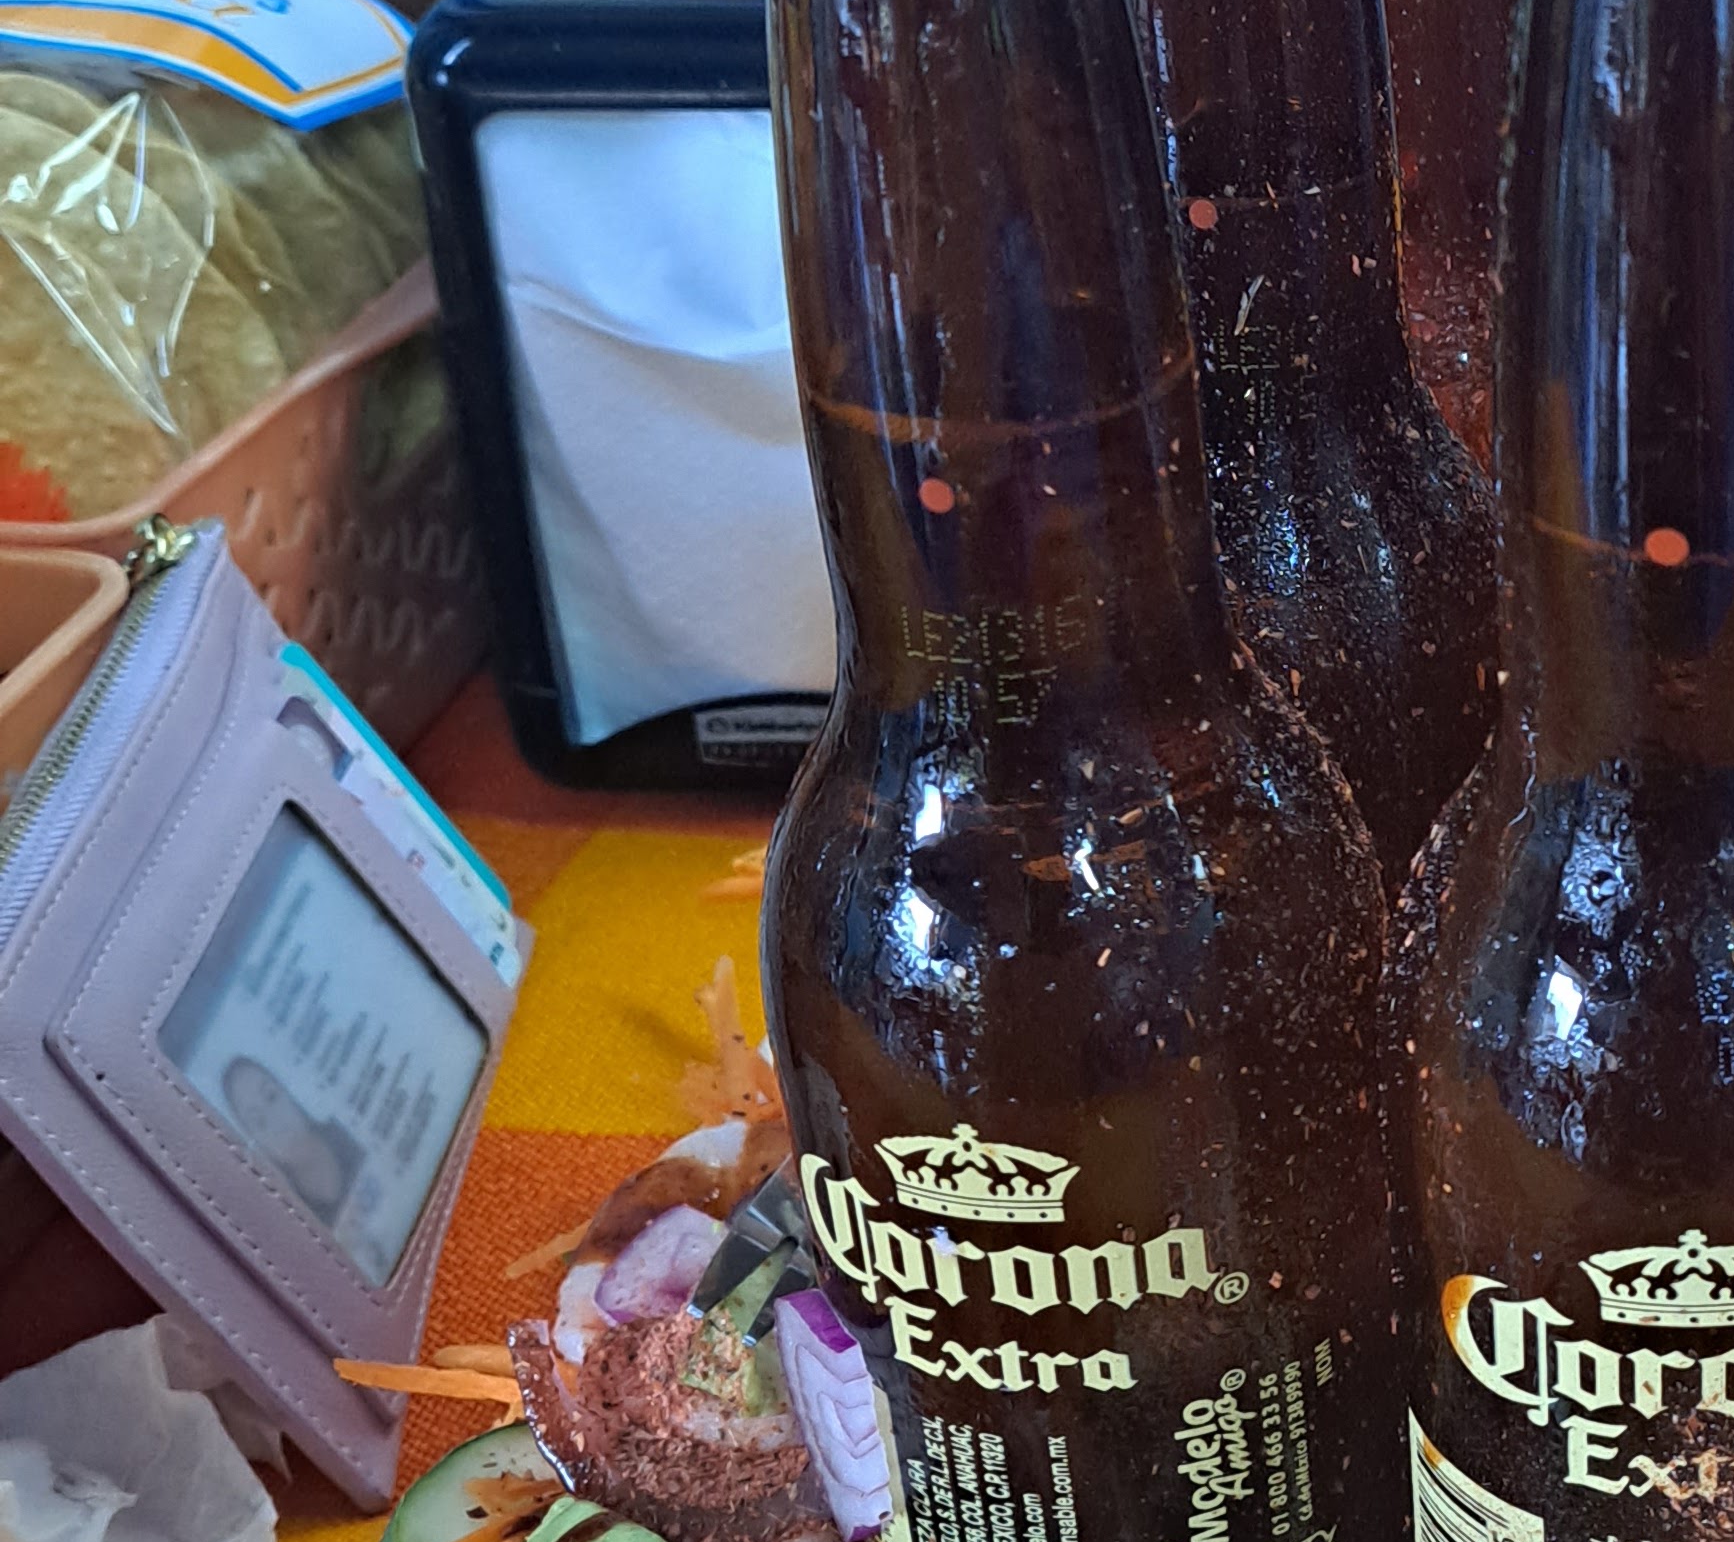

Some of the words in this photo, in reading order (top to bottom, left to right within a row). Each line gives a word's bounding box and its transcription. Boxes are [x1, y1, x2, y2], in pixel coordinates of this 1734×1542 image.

[884, 1296, 1138, 1394] Extra
[1314, 1337, 1333, 1387] NOM
[1258, 1373, 1279, 1400] 56
[1262, 1403, 1281, 1429] 33
[1208, 1393, 1257, 1500] Amigo
[1264, 1431, 1285, 1467] 466
[906, 1459, 932, 1516] CLARA
[1267, 1471, 1288, 1509] 800
[1271, 1512, 1291, 1536] 01
